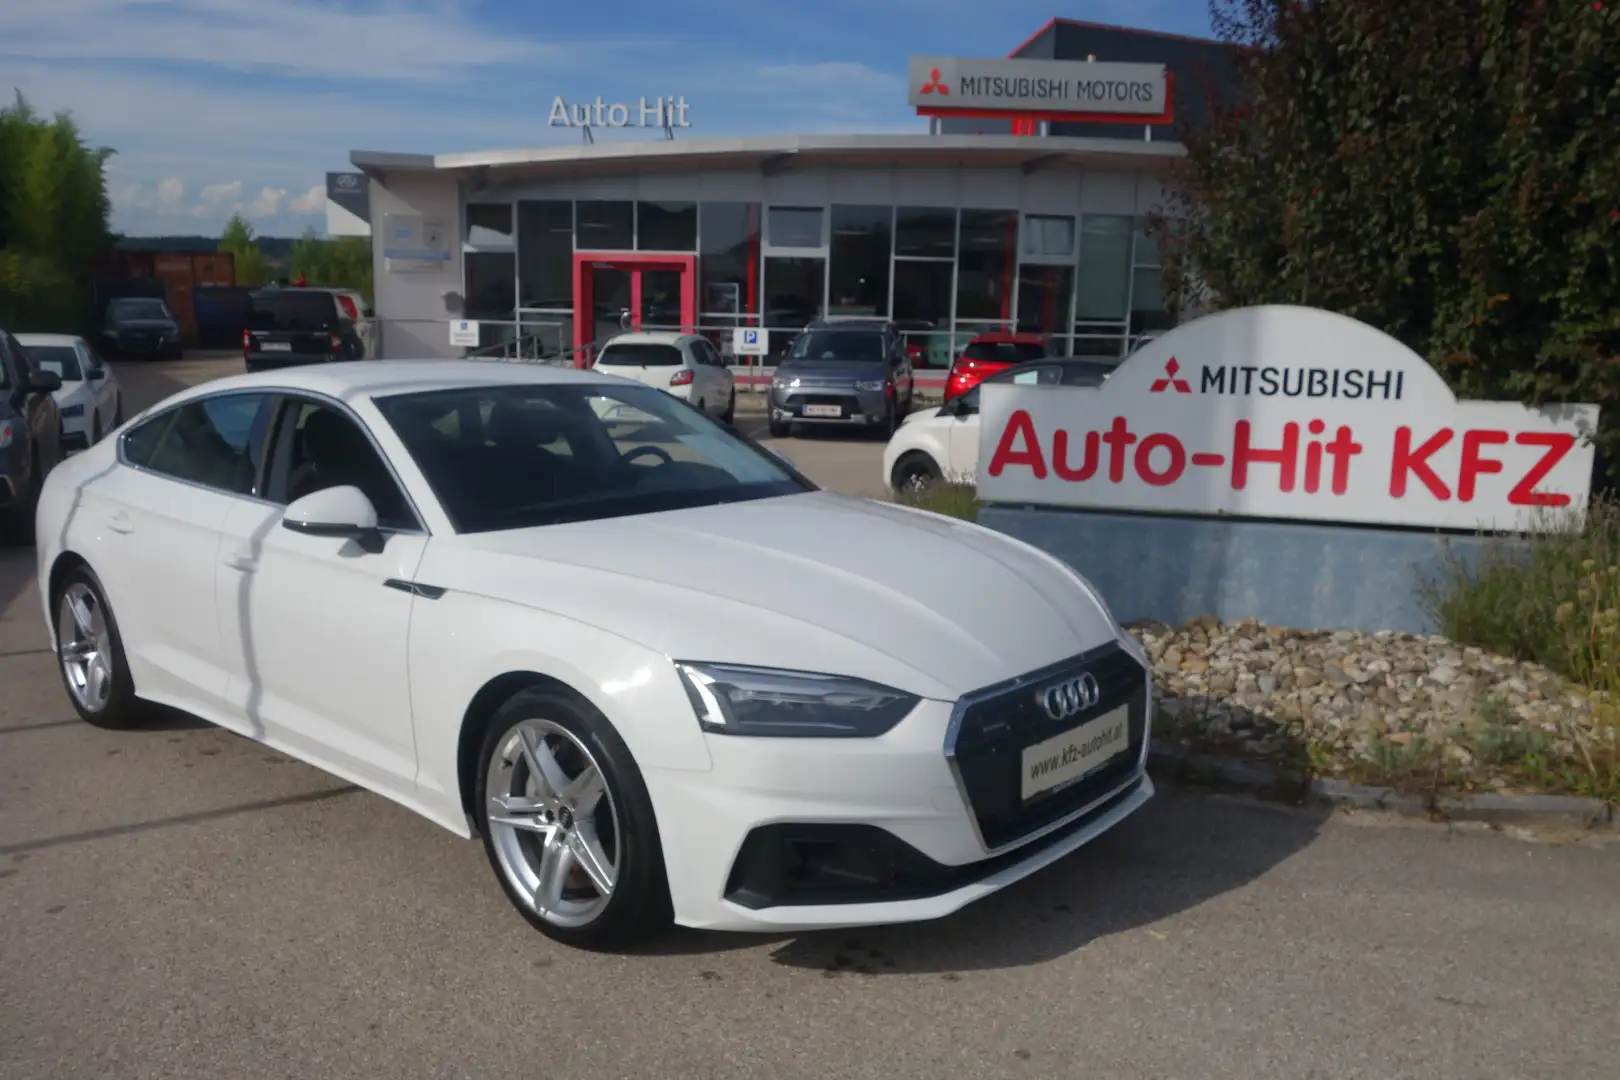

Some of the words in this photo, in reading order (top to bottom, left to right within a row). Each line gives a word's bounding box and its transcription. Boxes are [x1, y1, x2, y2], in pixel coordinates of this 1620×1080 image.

[961, 76, 1068, 99] MITSUBISHI
[1077, 80, 1154, 103] MOTORS
[549, 95, 628, 127] Auto
[639, 95, 690, 127] Hit
[1201, 365, 1404, 400] MITSUBISHI
[988, 410, 1362, 496] Auto-Hit
[1389, 426, 1576, 507] KFZ
